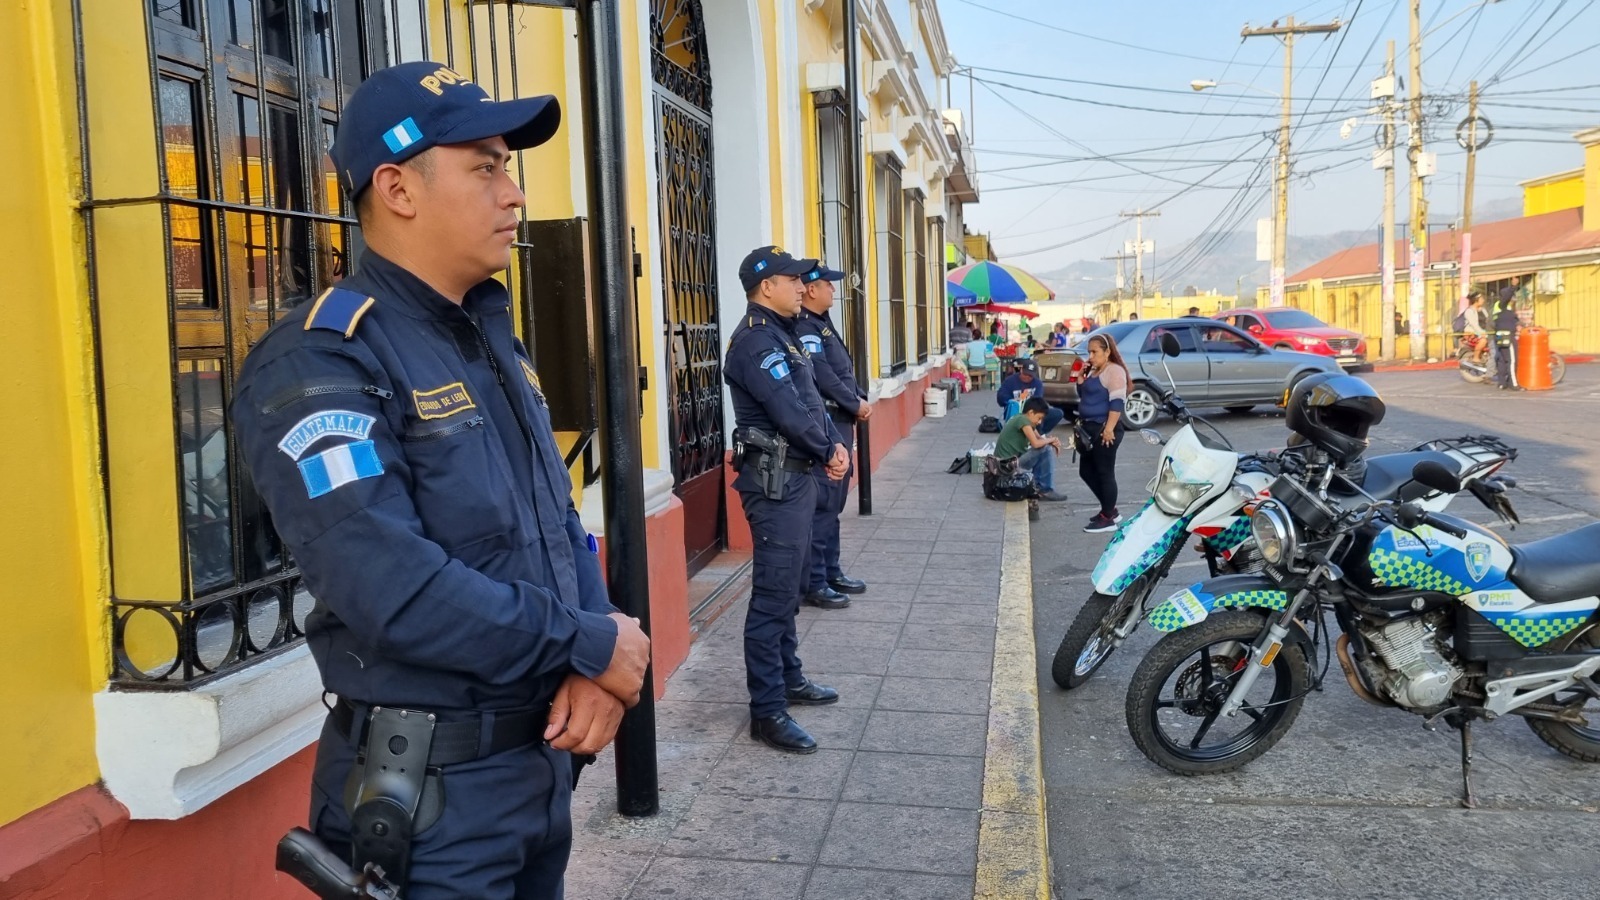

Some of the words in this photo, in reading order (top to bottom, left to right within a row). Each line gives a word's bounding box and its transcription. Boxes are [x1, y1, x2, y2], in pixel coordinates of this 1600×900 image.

[441, 396, 453, 406] DE
[287, 415, 364, 453] GUATEMALA
[1182, 592, 1206, 615] PMT
[1489, 592, 1512, 601] PMT
